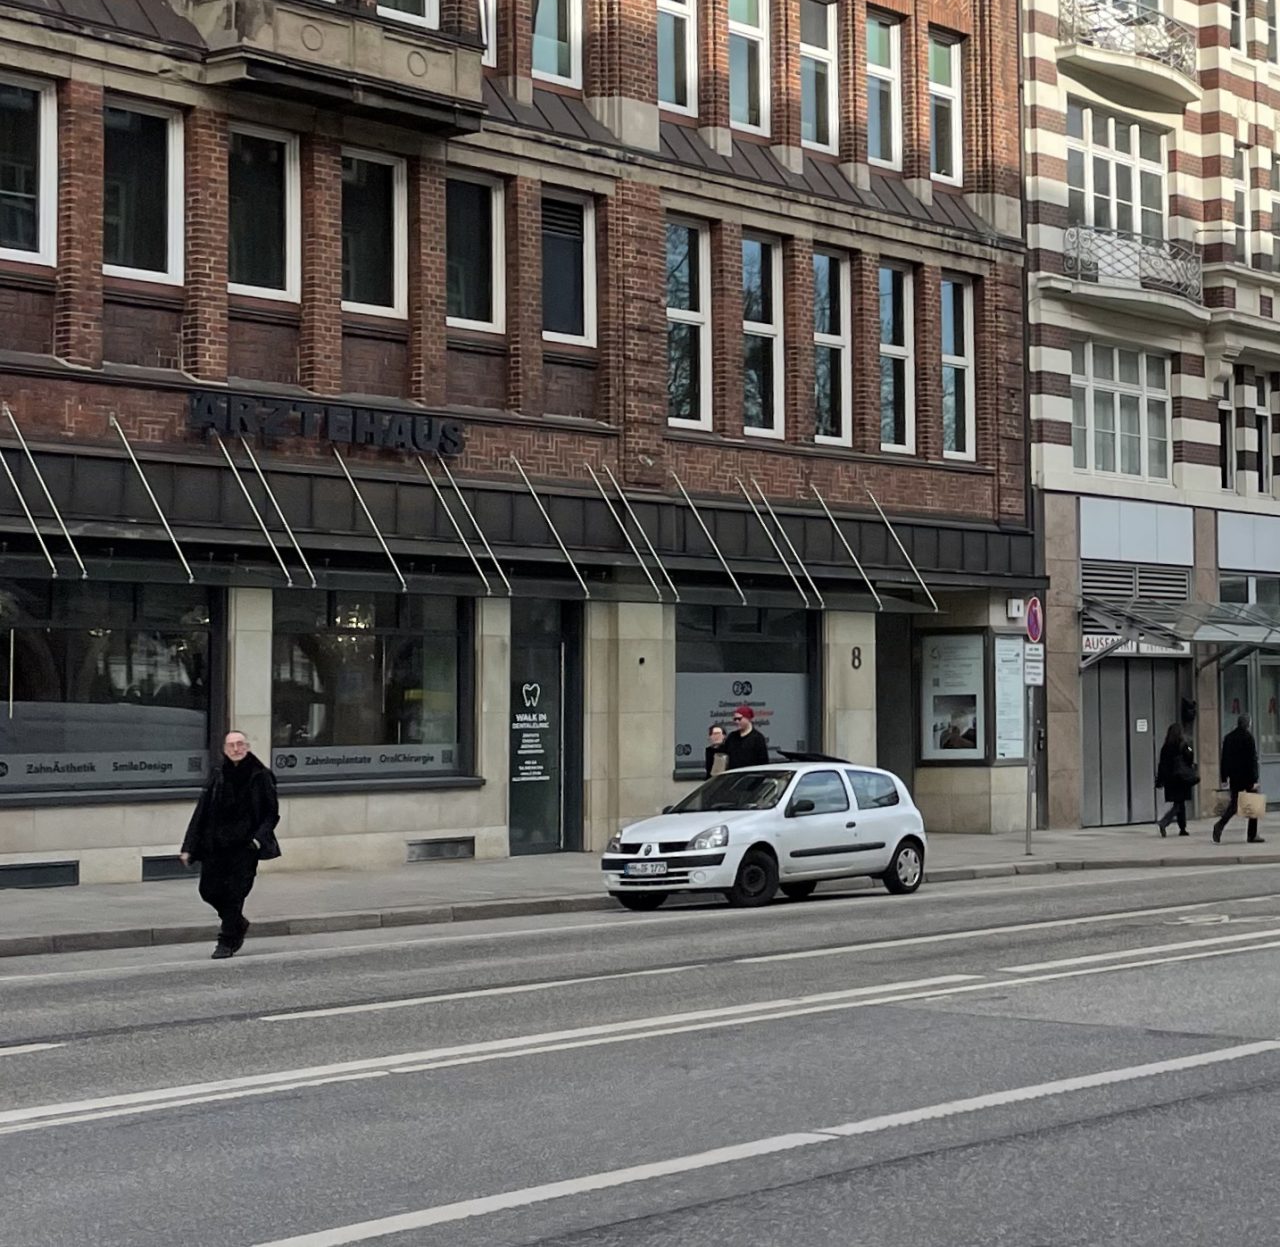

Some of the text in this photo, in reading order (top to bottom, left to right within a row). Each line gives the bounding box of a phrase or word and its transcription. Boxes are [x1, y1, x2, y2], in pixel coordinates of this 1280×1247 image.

[851, 646, 862, 669] 8
[516, 713, 547, 722] WALK IN
[379, 752, 435, 765] OralChirurgie
[26, 761, 174, 774] ZahnÄsthetik SmileDesign
